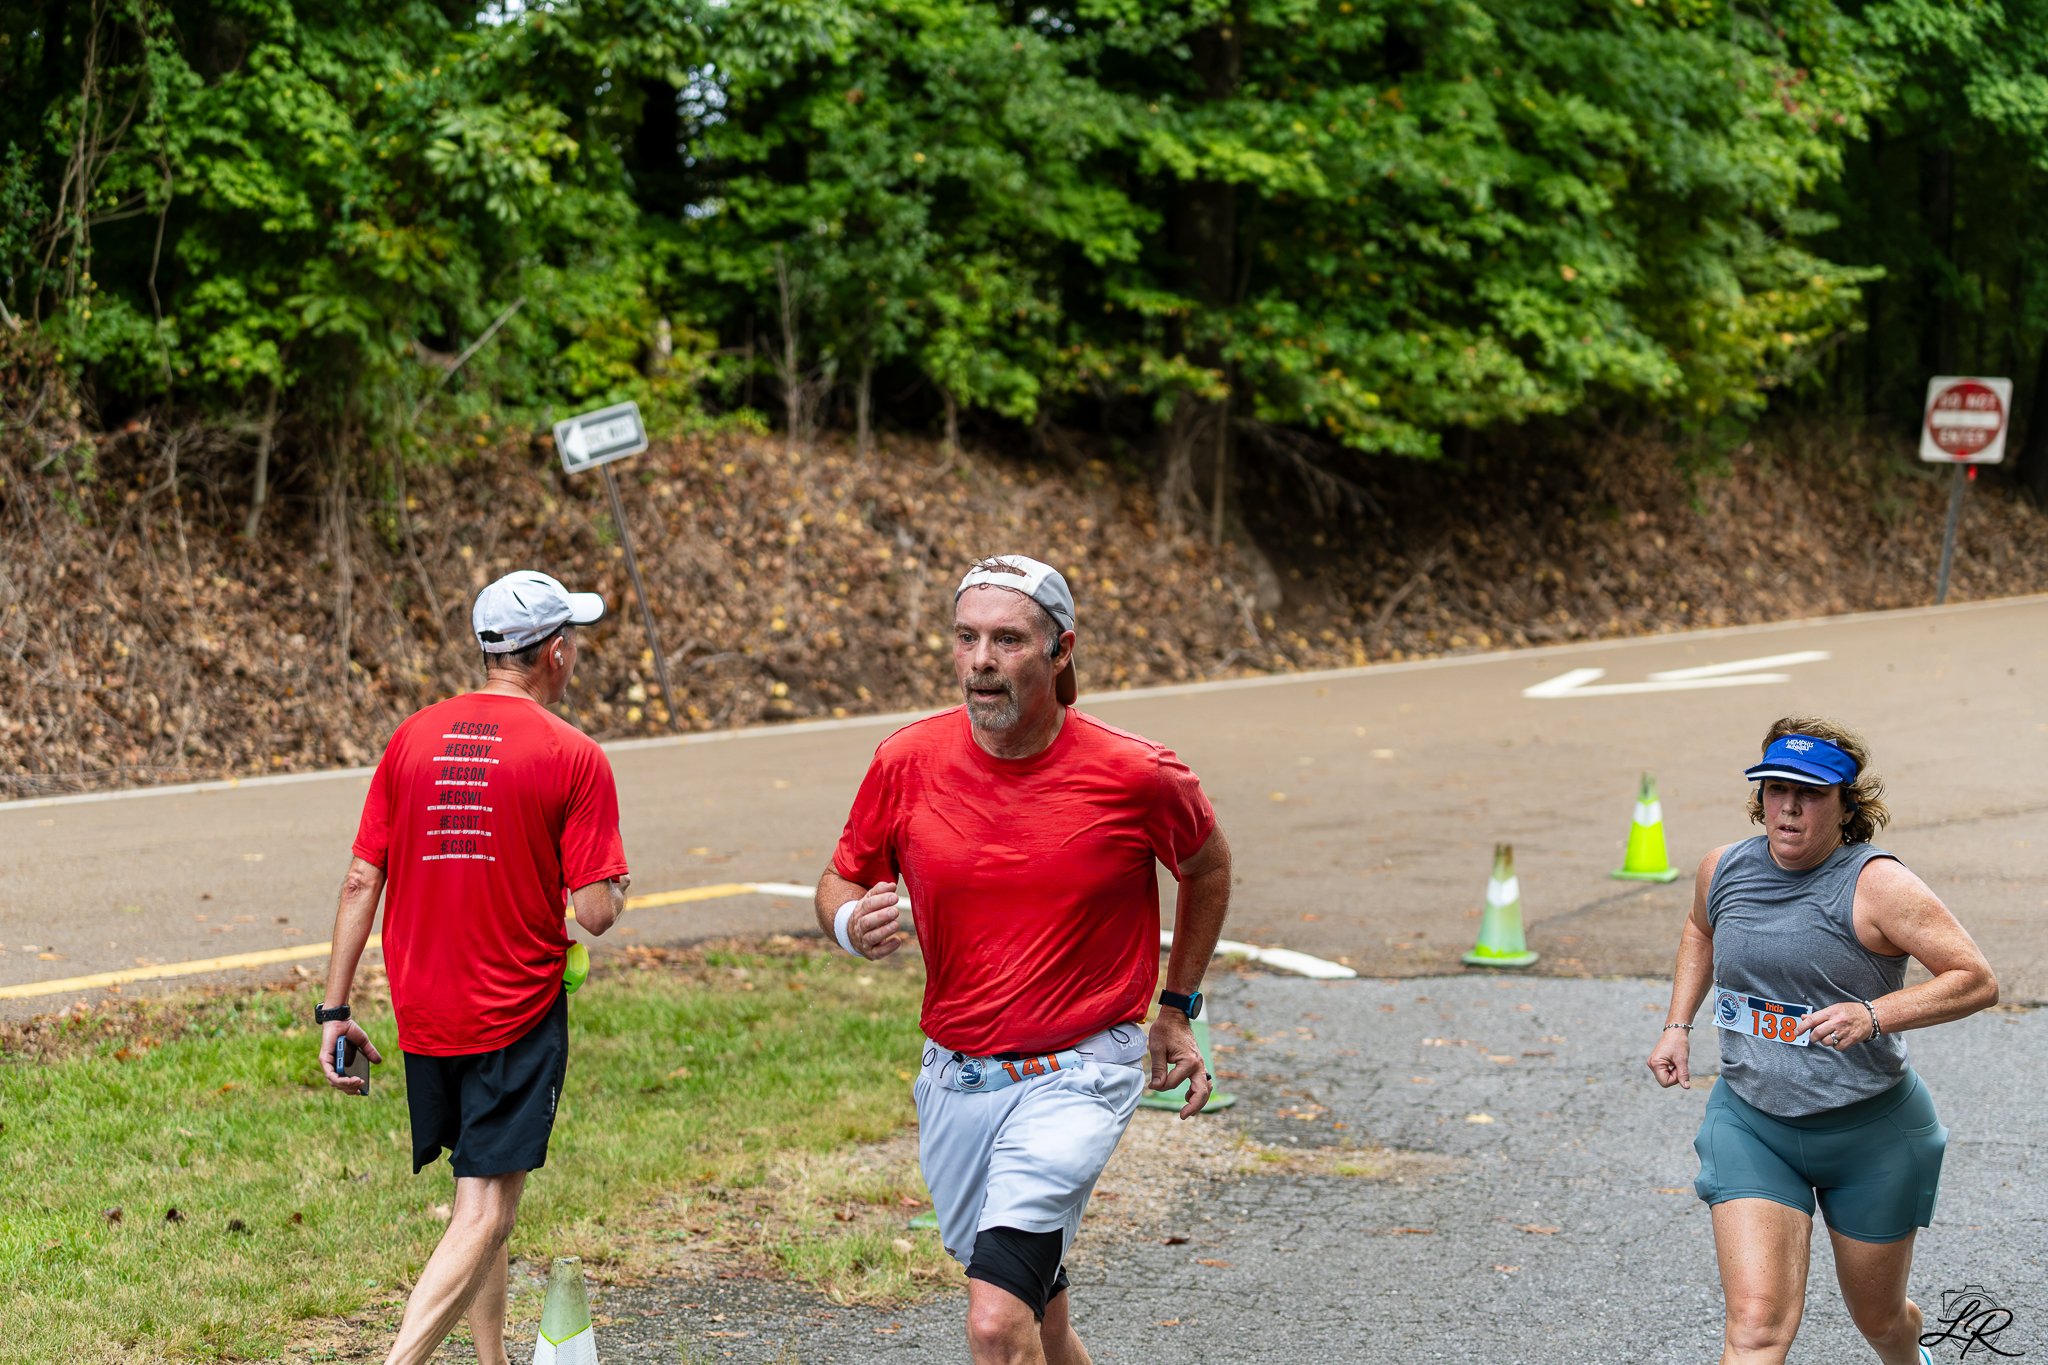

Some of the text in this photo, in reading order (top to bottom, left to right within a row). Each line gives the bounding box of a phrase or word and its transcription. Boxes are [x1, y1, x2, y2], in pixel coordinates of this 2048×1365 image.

[451, 721, 499, 736] #ECSDC
[444, 743, 492, 758] #ECSNY
[441, 766, 486, 781] #ECSON
[439, 790, 482, 805] #ECSWI
[1764, 1002, 1784, 1014] Tricia
[1751, 1009, 1797, 1043] 138
